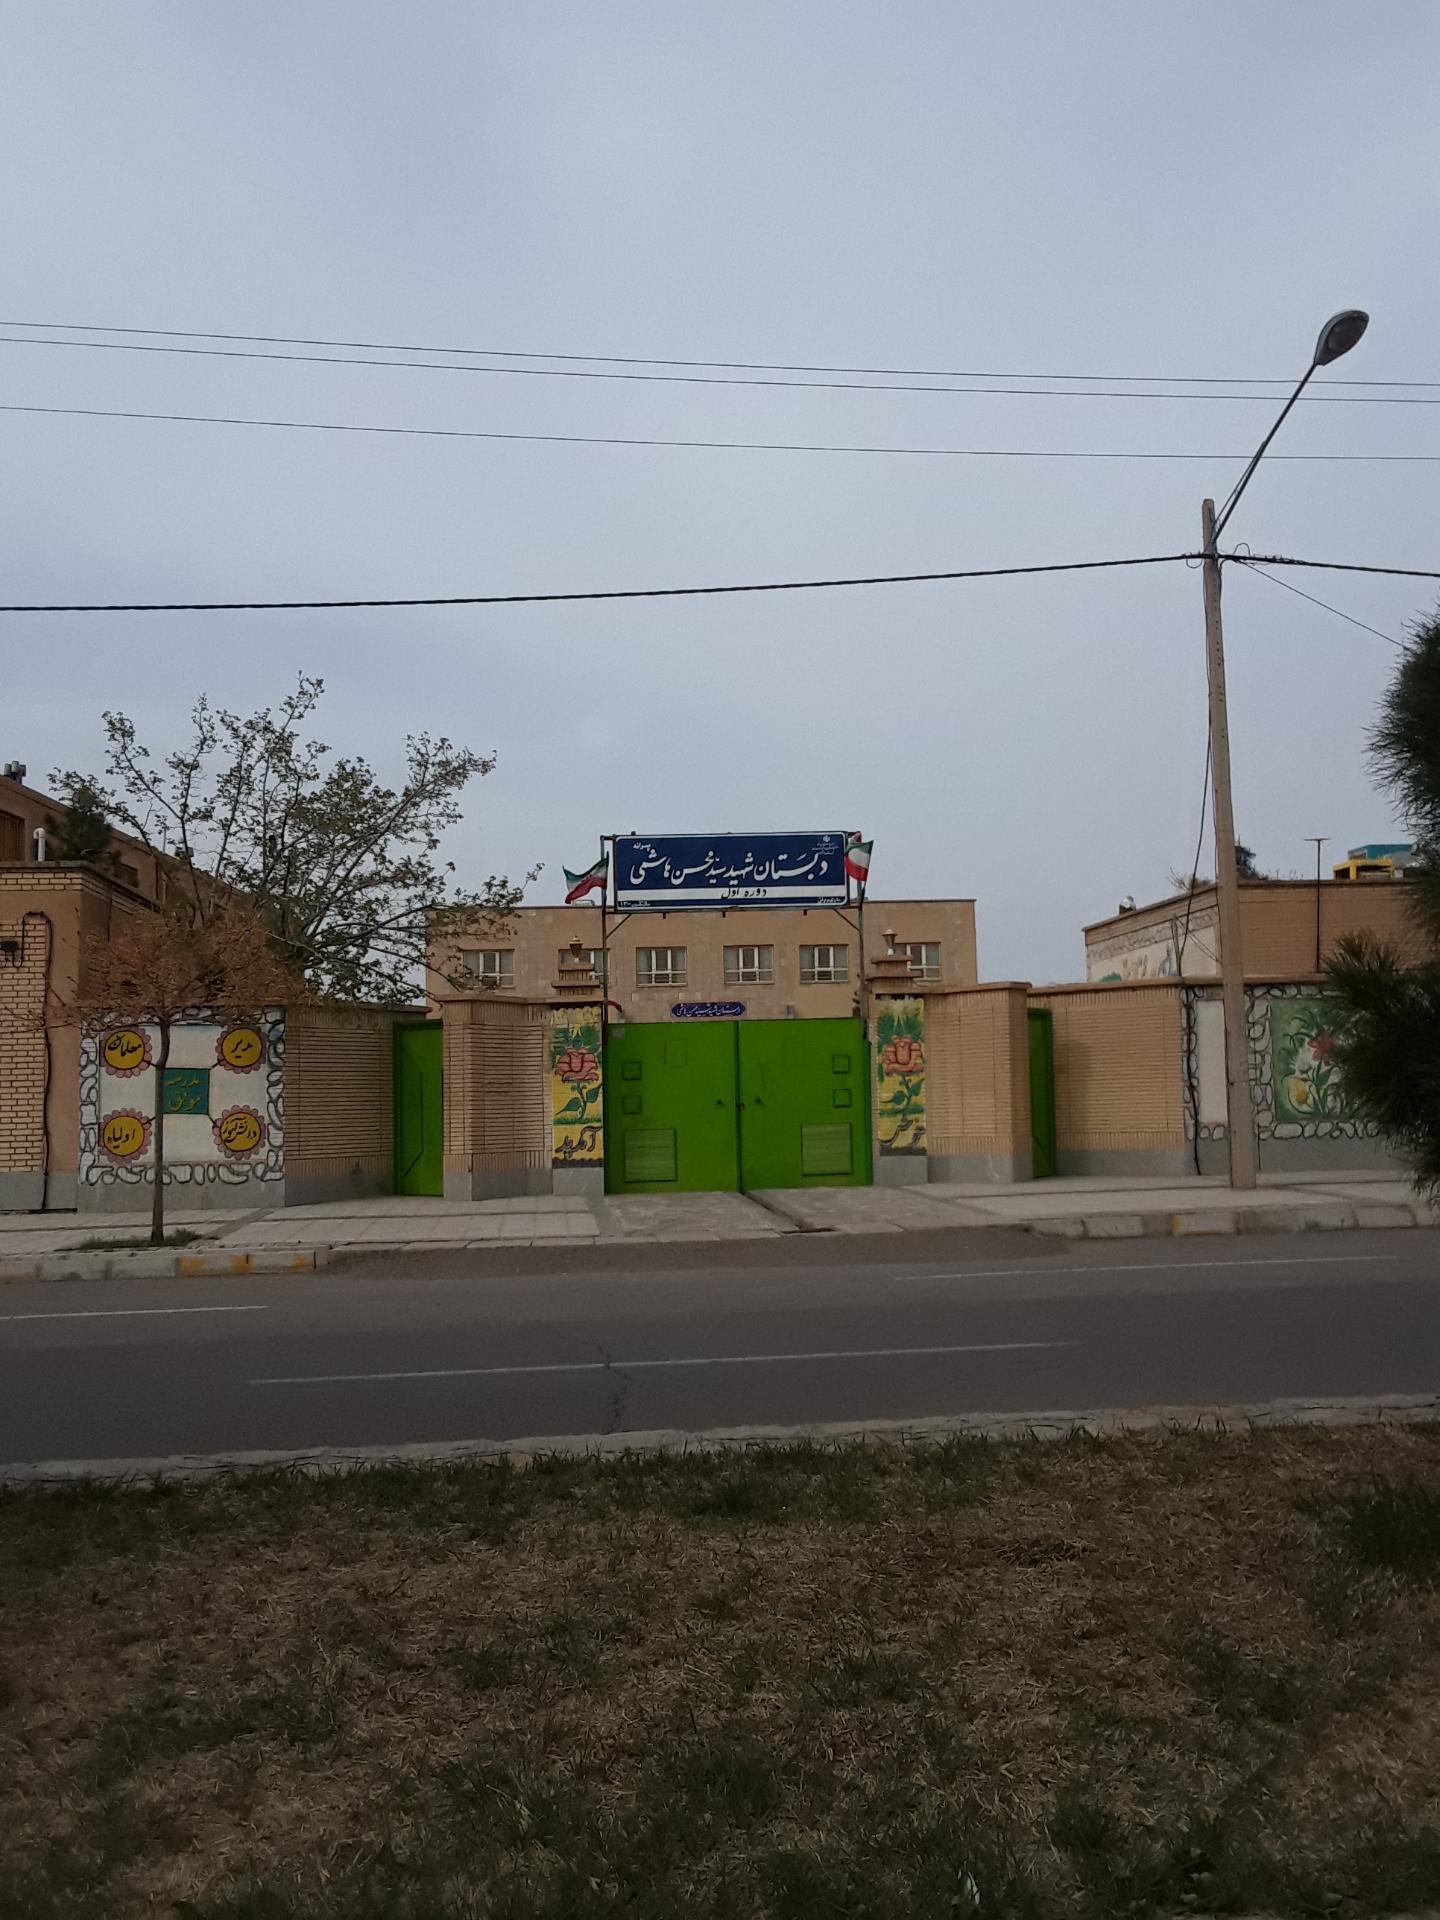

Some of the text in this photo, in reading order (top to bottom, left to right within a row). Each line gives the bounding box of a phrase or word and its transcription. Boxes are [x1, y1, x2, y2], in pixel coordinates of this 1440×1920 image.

[629, 848, 672, 886] هاشمی
[670, 850, 715, 886] محسن
[723, 852, 754, 886] شهید
[754, 852, 829, 882] دبستان
[720, 886, 767, 900] دوره اول
[107, 1034, 142, 1057] معلمان
[230, 1038, 253, 1059] مدیر
[164, 1074, 200, 1087] مدرسه
